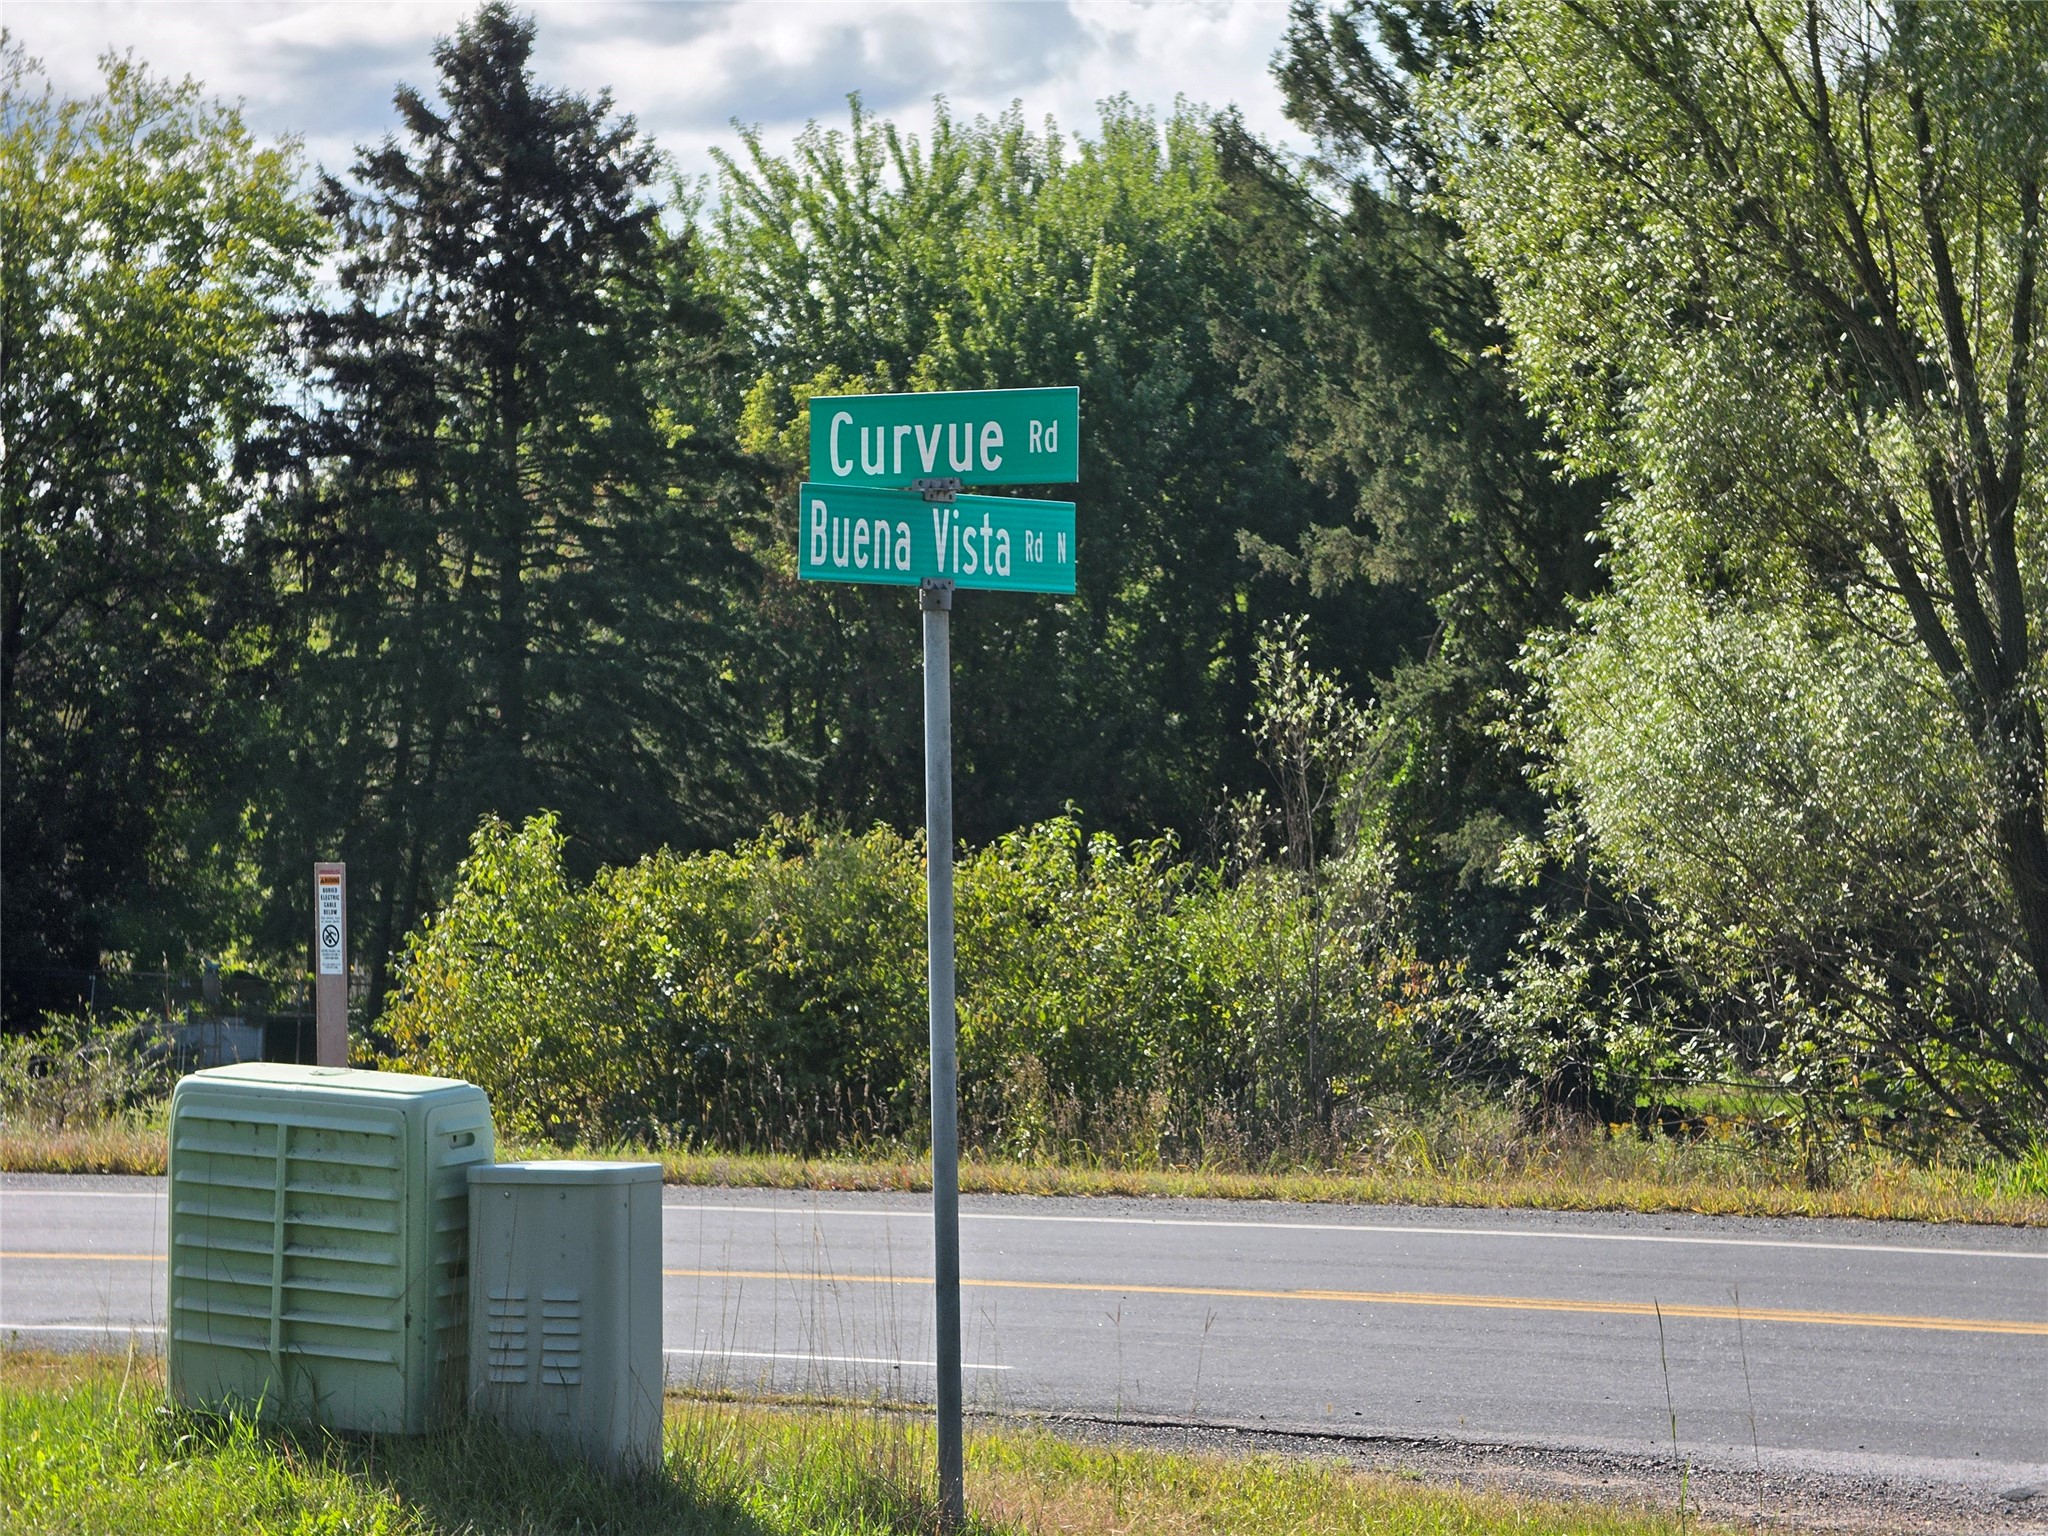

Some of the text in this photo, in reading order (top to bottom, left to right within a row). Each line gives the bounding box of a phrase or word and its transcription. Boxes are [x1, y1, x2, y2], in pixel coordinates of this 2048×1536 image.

[830, 411, 1058, 477] Curvue Rd
[810, 499, 1066, 577] Buena Vista Rd N
